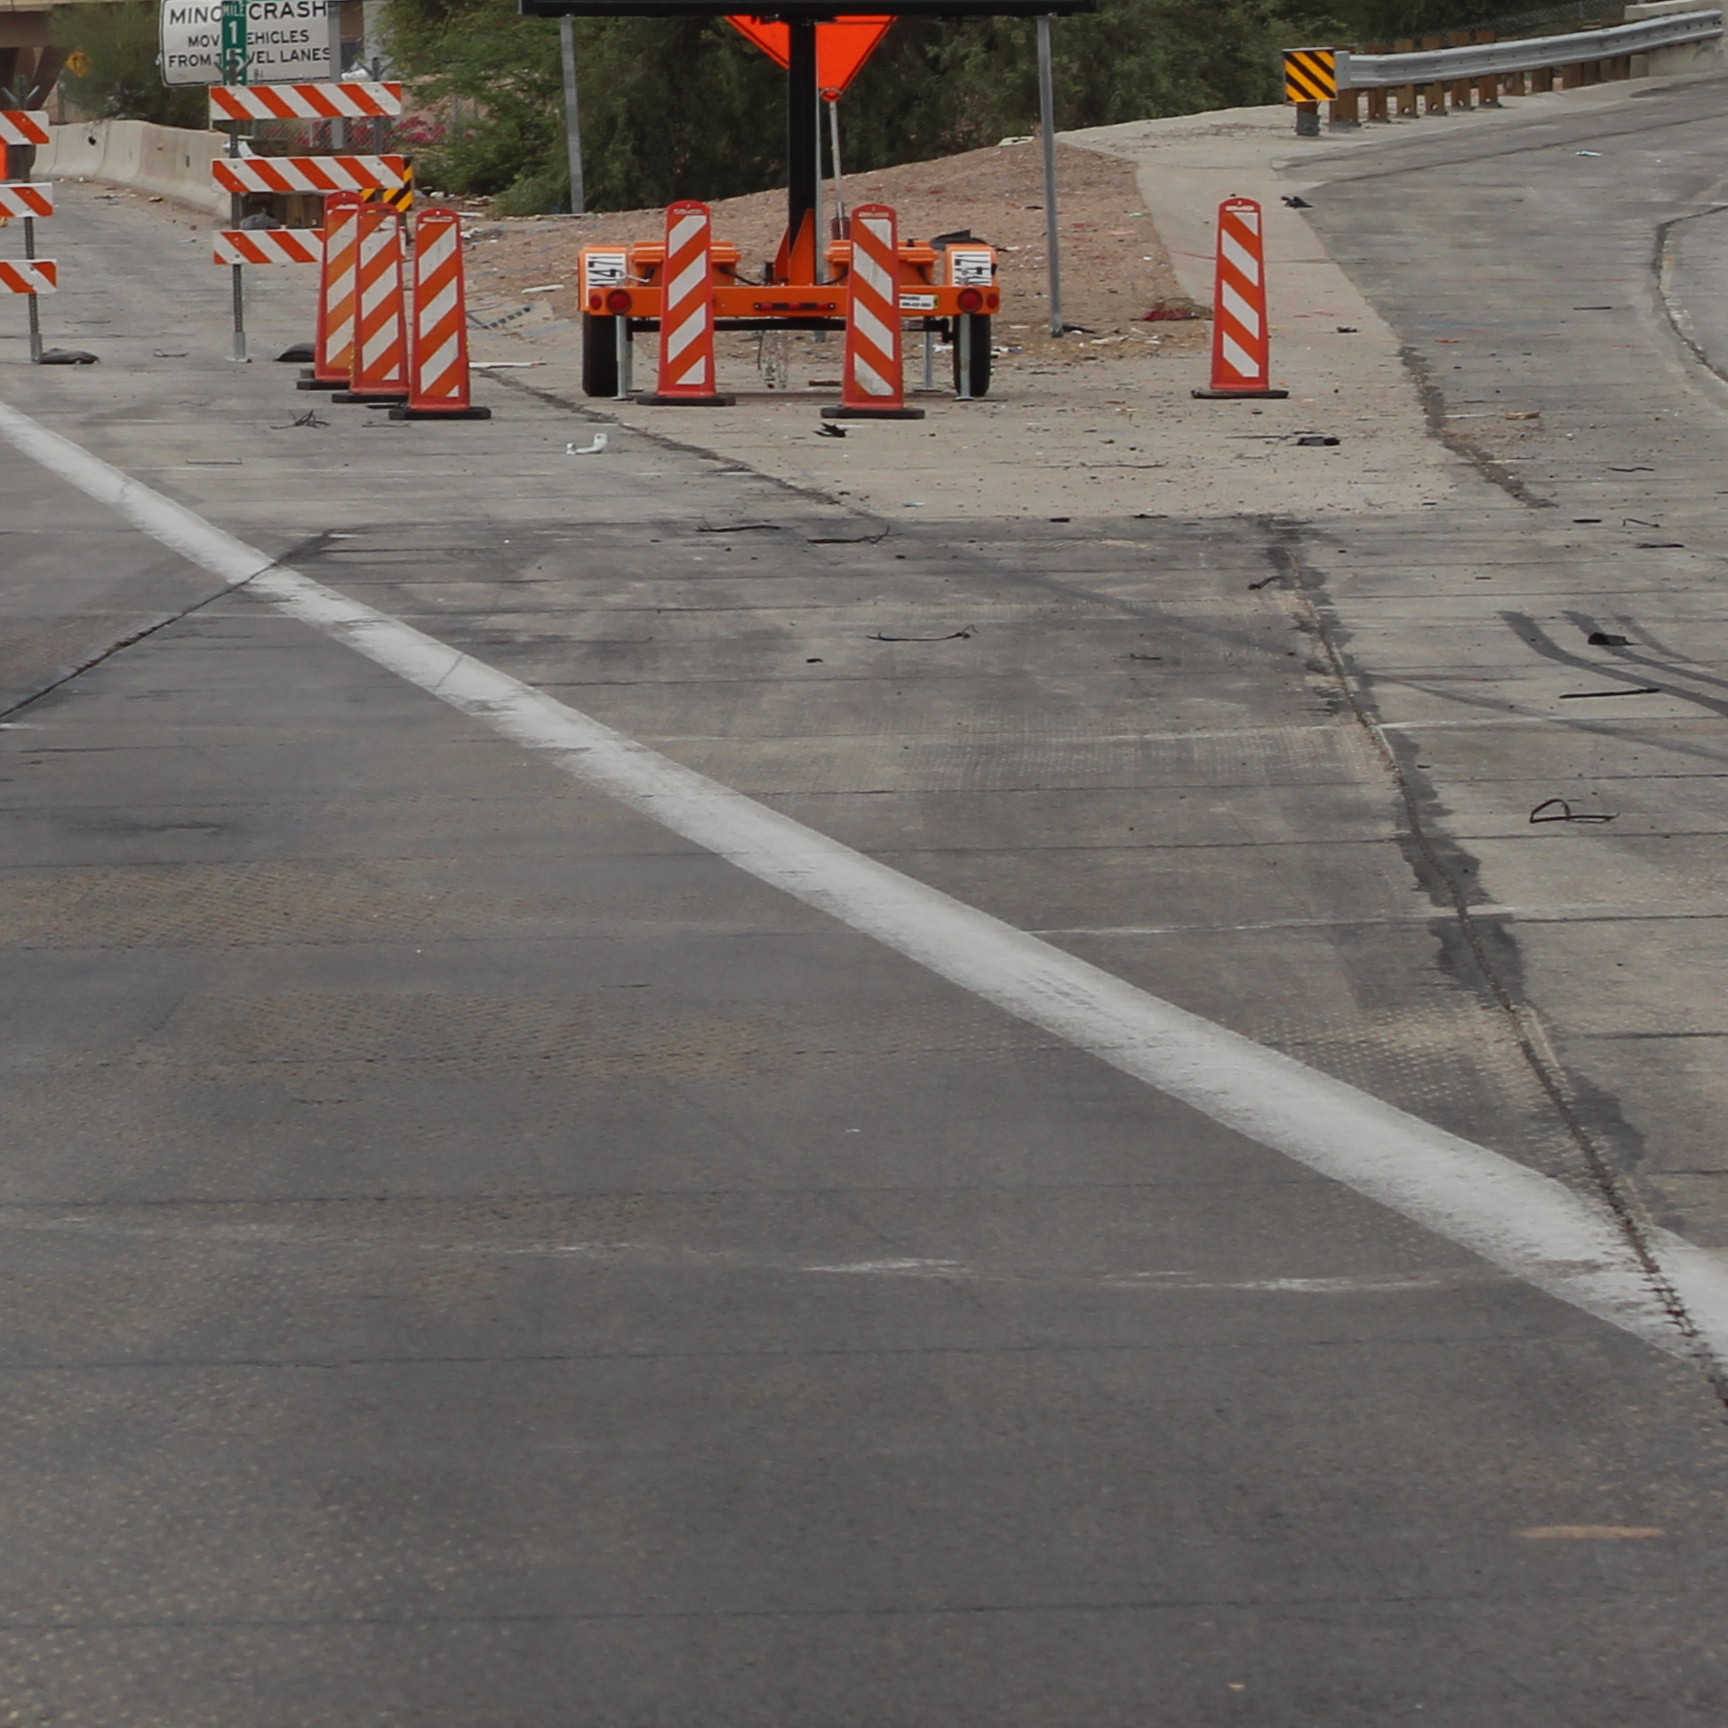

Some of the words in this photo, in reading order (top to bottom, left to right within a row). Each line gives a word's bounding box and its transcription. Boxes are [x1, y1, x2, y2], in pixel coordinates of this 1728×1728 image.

[249, 1, 327, 20] CRASH
[169, 54, 211, 68] FROM
[280, 48, 331, 63] LANES
